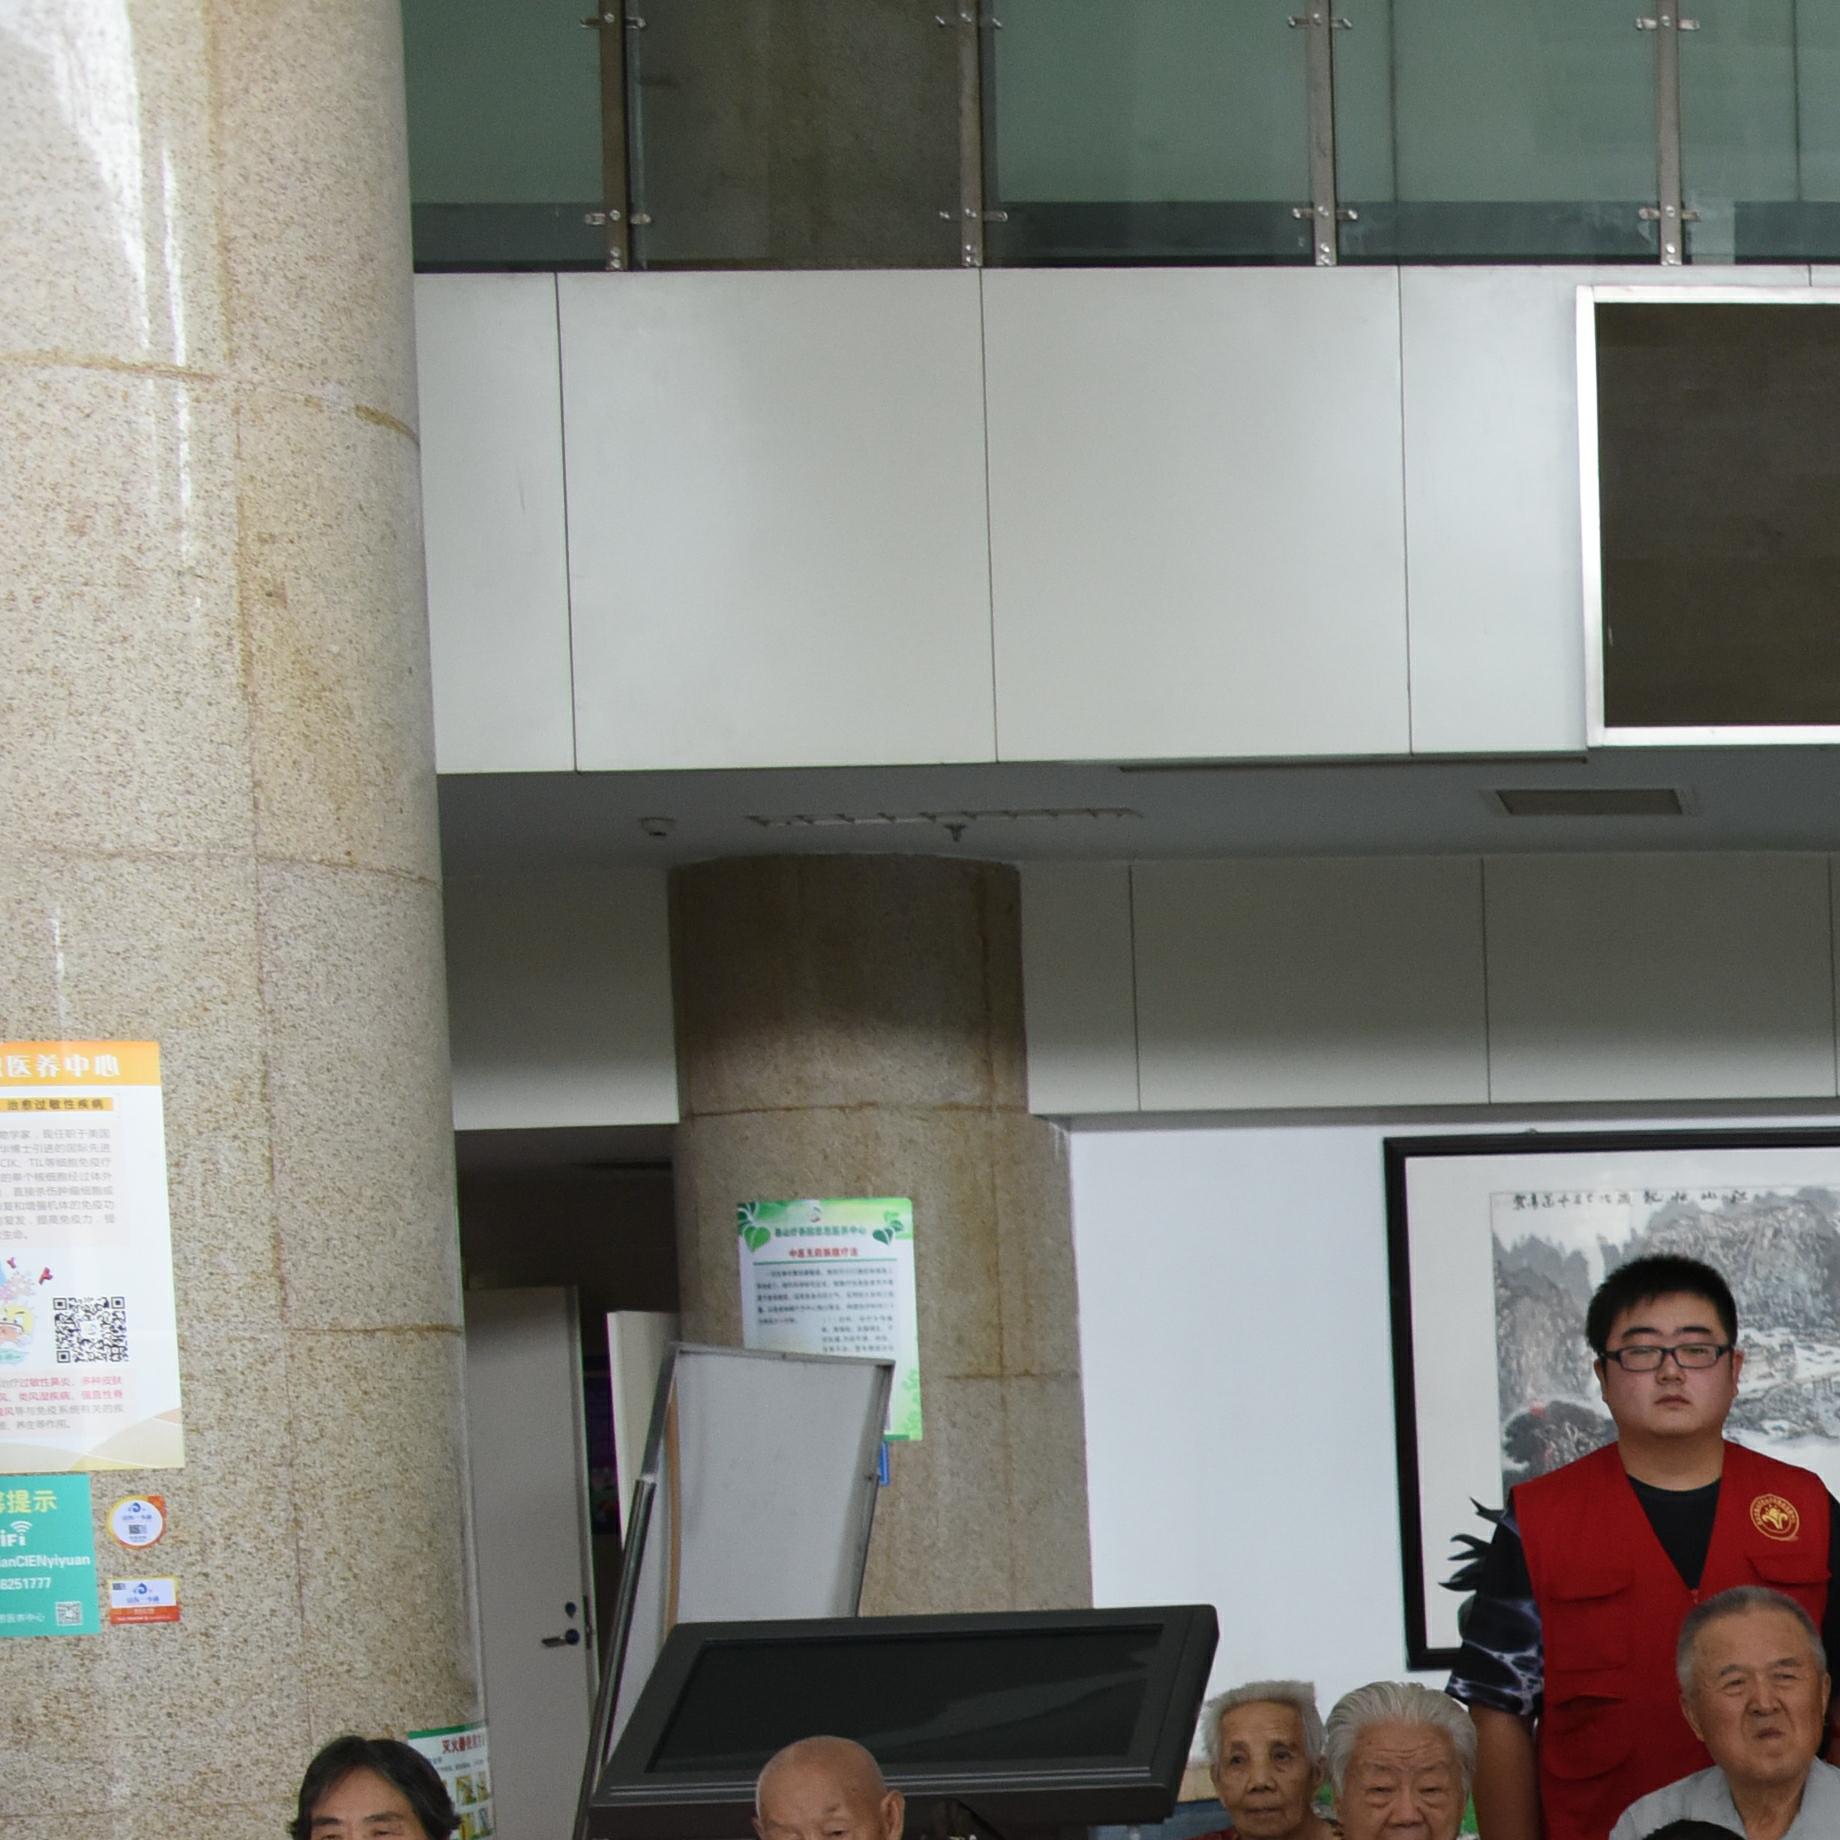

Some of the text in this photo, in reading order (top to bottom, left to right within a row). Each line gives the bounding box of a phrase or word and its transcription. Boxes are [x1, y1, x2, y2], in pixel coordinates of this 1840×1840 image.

[0, 1054, 120, 1077] 医养中心
[0, 1489, 57, 1513] 提示
